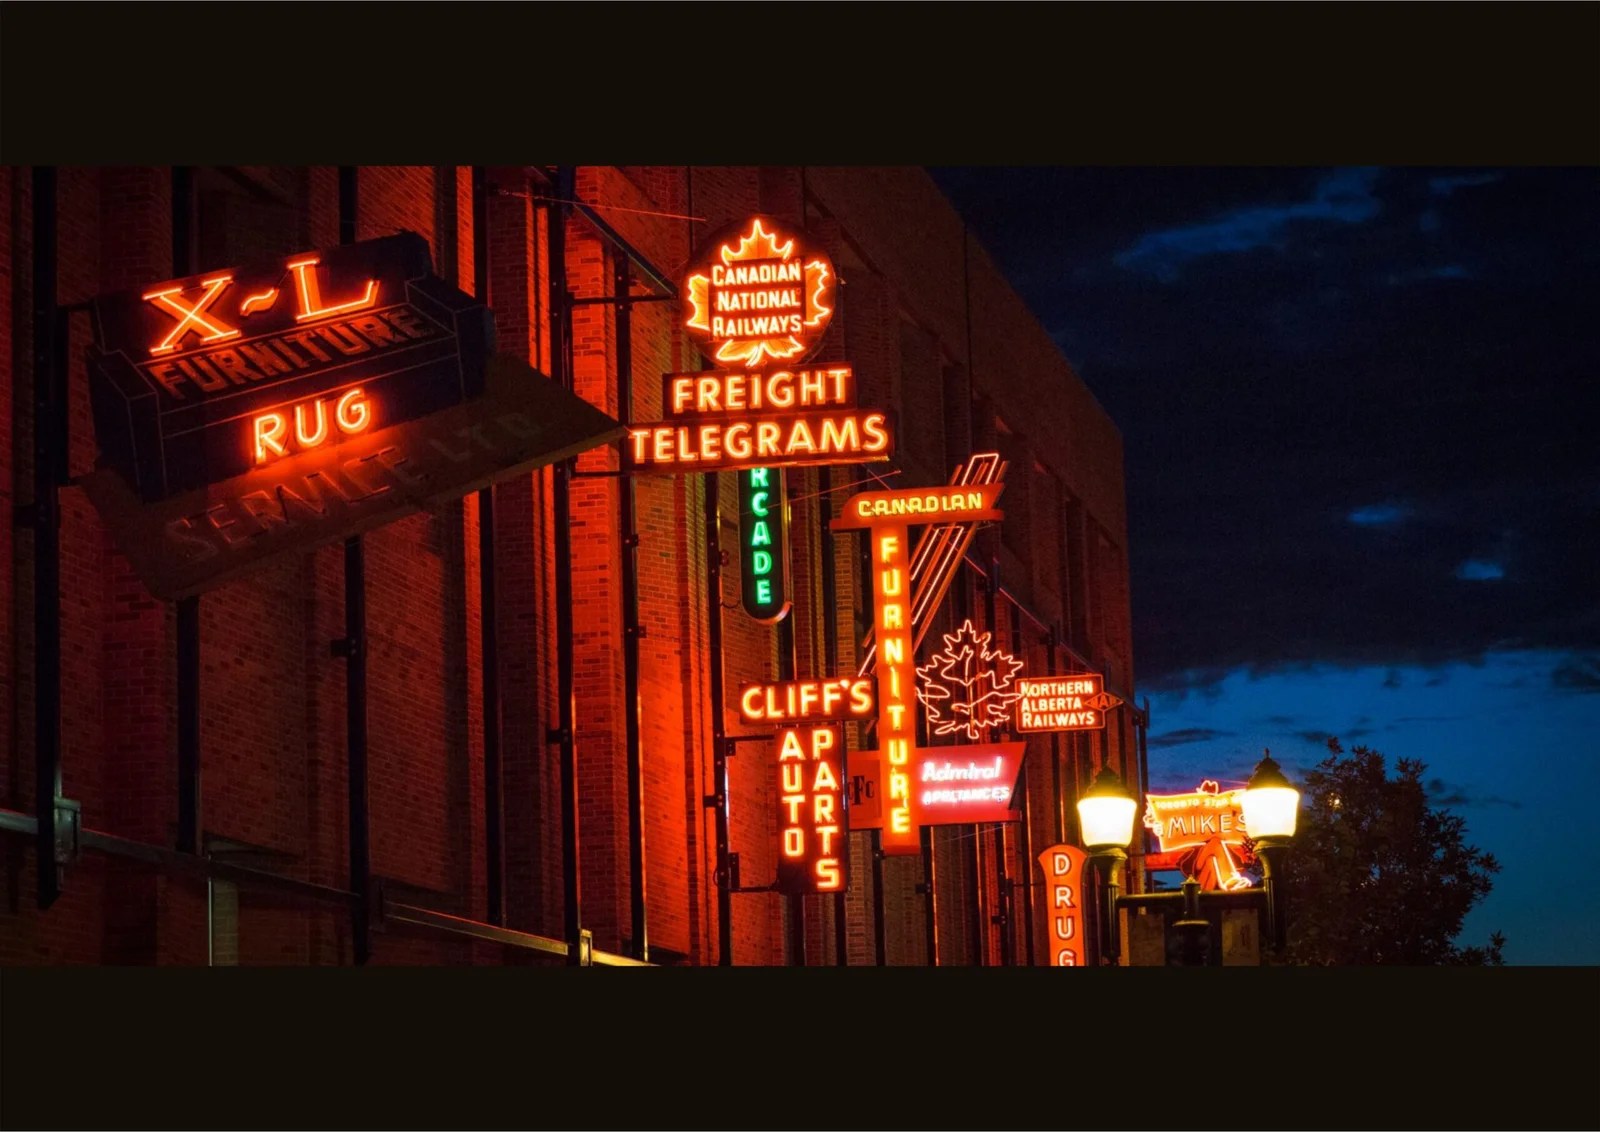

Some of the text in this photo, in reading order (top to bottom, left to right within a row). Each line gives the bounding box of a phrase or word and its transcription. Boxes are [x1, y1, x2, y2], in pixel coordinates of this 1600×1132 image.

[712, 261, 801, 286] CANADIAN
[717, 290, 801, 311] NATIONAL
[712, 314, 802, 337] RAILWAYS
[150, 308, 434, 400] FURNITURE
[672, 368, 852, 414] FREIGHT
[252, 388, 372, 463] RUG
[629, 414, 889, 463] TELEGRAMS
[858, 492, 983, 518] CANADIAN
[741, 679, 874, 719] CLIFF'S
[880, 536, 911, 834] FURNITURE
[1020, 680, 1094, 697] NORTHERN
[1021, 697, 1082, 712] ALBERTA
[1022, 711, 1096, 728] RAILWAYS
[921, 755, 1003, 782] Admiral
[779, 731, 806, 858] AUTO
[811, 729, 840, 889] PARTS
[1053, 852, 1076, 966] DRUG
